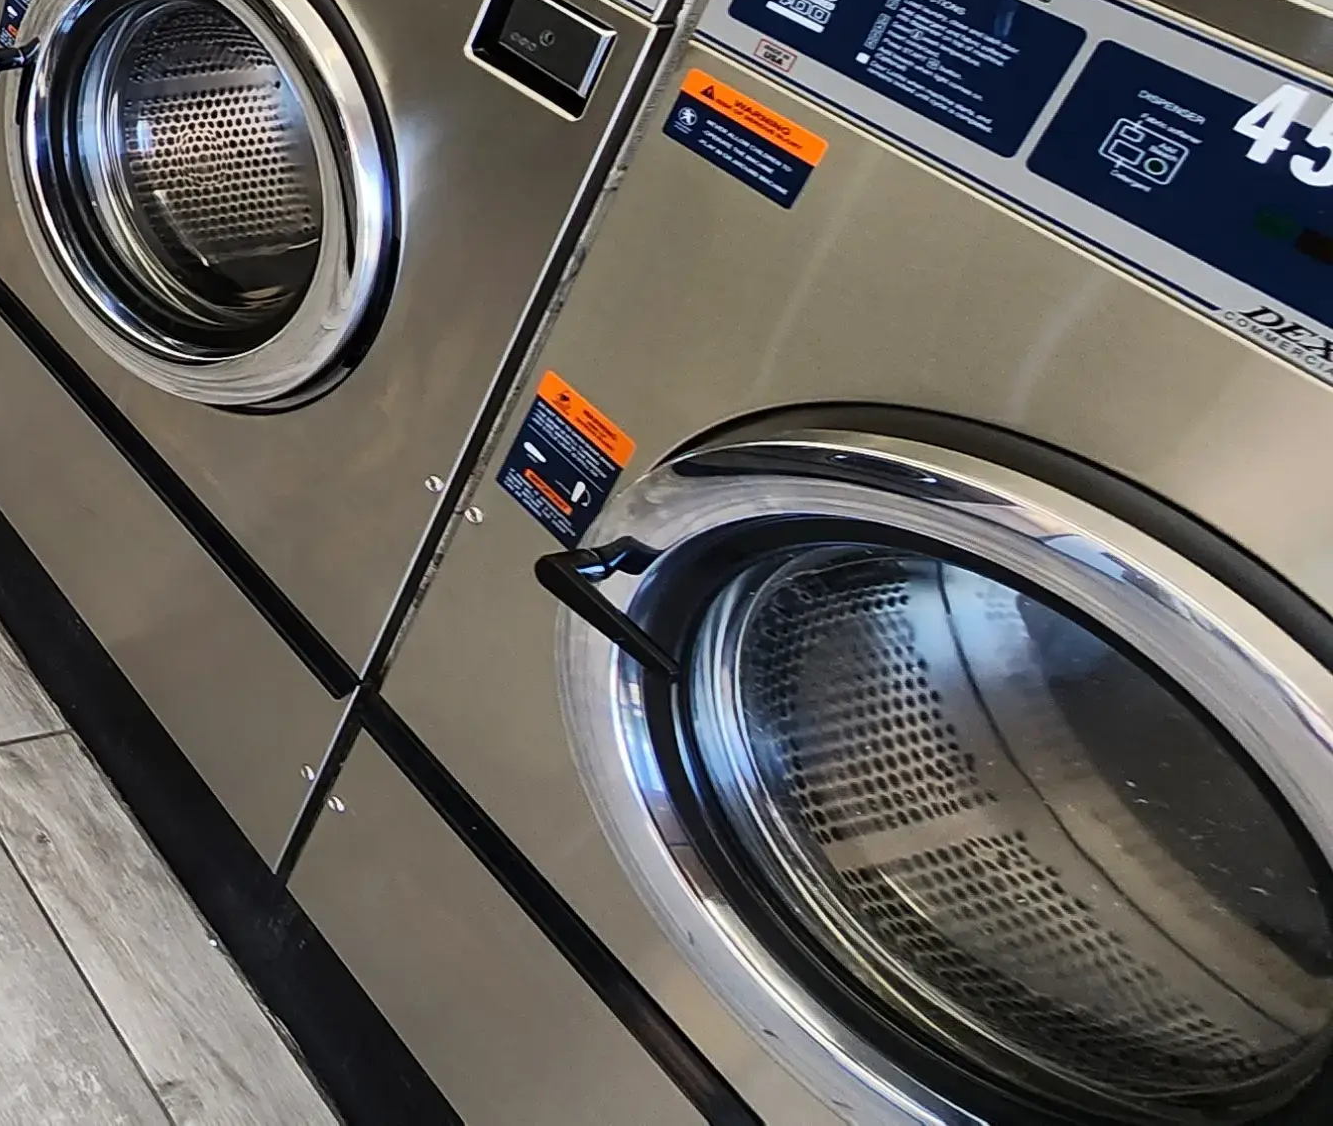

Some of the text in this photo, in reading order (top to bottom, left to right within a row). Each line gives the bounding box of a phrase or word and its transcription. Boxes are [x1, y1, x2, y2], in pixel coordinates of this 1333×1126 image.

[763, 51, 783, 65] USA
[1137, 89, 1206, 125] DISPENSER
[1232, 83, 1333, 187] 45
